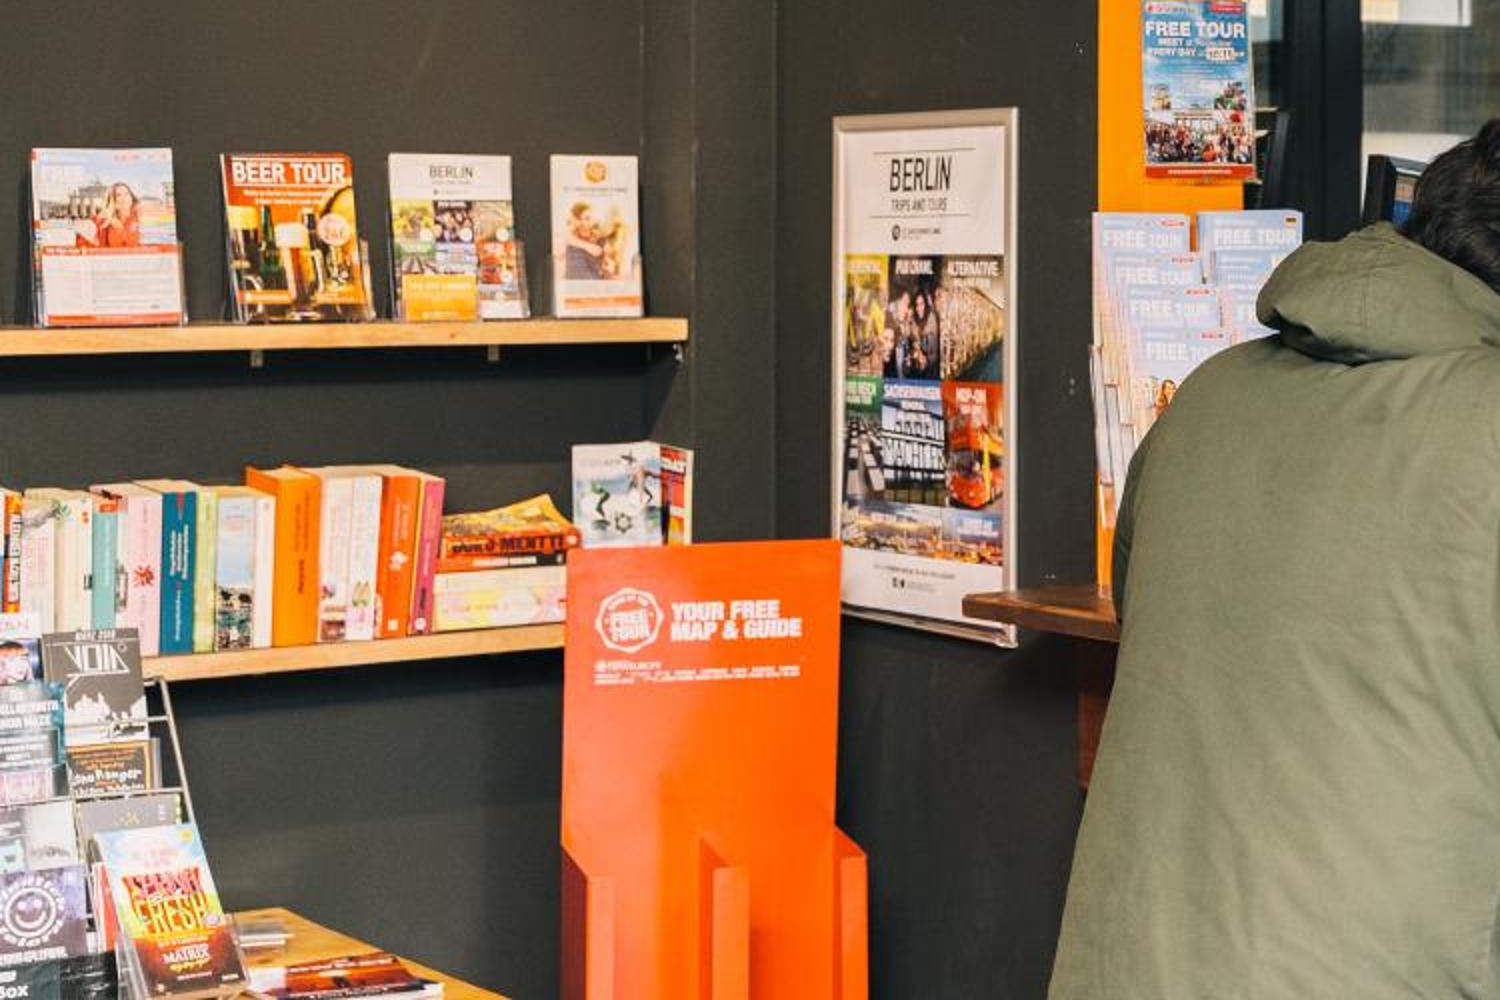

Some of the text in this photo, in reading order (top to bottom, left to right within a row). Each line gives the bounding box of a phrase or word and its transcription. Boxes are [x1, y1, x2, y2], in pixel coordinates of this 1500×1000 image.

[1145, 20, 1245, 38] FREE TOUR
[232, 161, 345, 184] BEER TOUR
[429, 165, 474, 179] BERLIN
[889, 155, 952, 193] BERLIN
[890, 198, 911, 213] TRIPS
[1103, 229, 1147, 249] FREE
[1213, 227, 1298, 248] FREE TOUR
[608, 609, 649, 627] FREE
[671, 601, 725, 622] YOUR
[730, 599, 781, 621] FREE
[610, 623, 651, 644] TOUR
[671, 616, 803, 643] MAP & GUIDE
[160, 943, 211, 965] MATRIX
